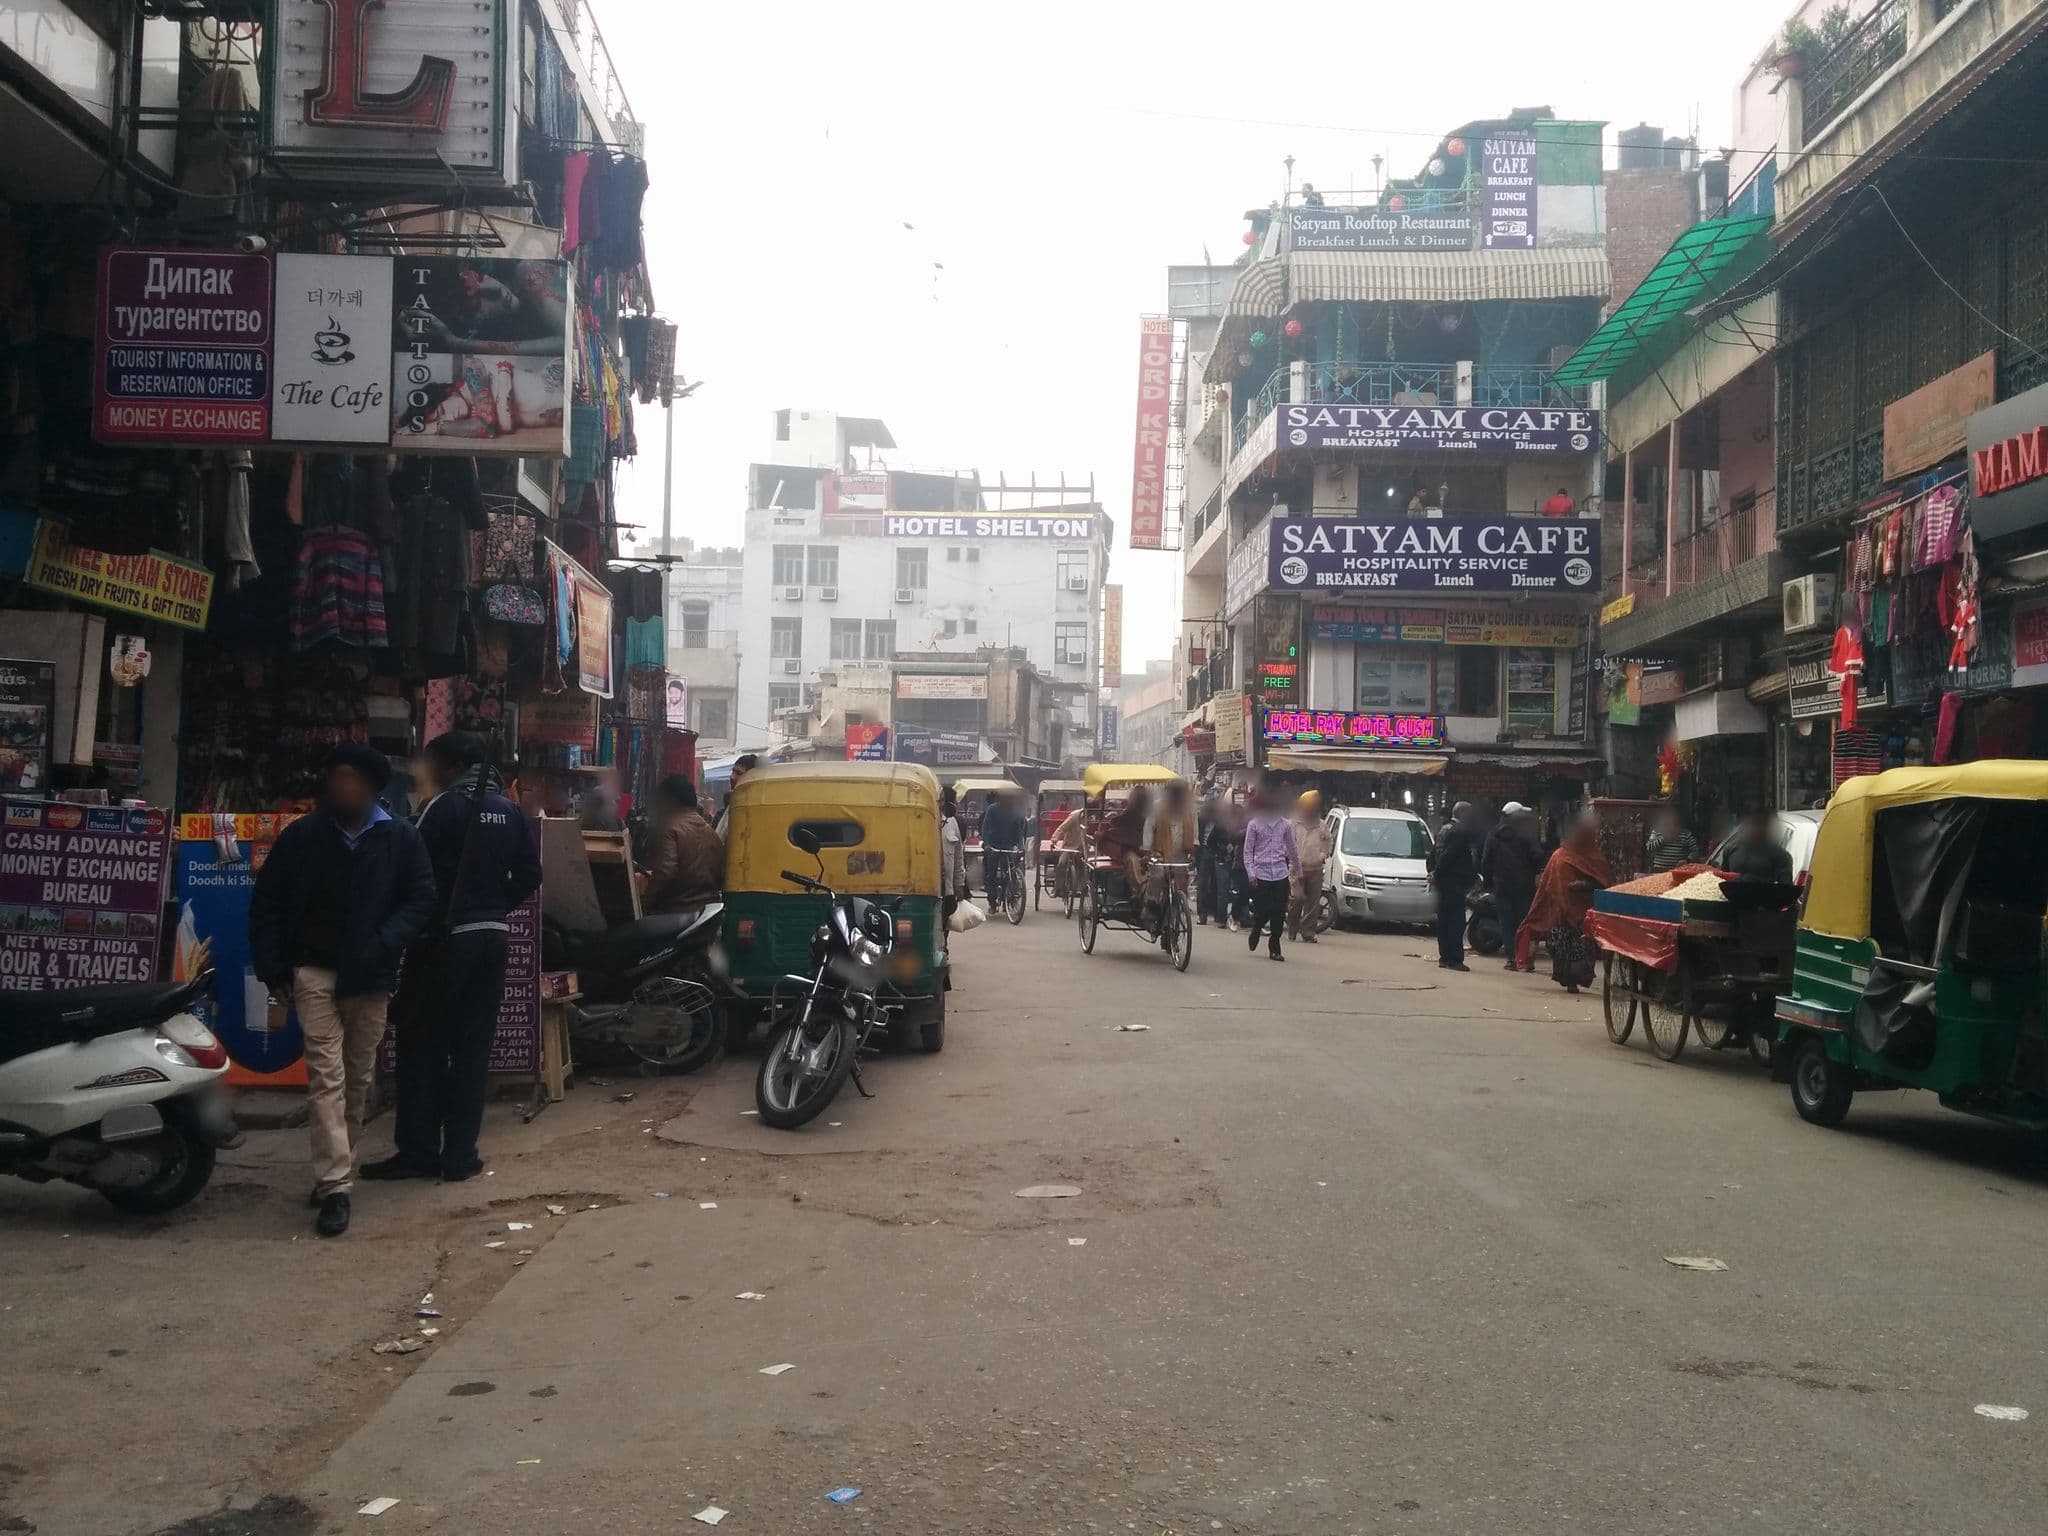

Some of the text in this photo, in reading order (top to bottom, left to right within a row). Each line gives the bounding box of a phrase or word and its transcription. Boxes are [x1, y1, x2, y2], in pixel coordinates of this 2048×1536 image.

[1484, 139, 1536, 155] SATYAM
[1493, 157, 1528, 174] CAFE
[1487, 177, 1533, 186] BREAKFAST
[1494, 192, 1526, 201] LUNCH
[1492, 208, 1528, 217] DINNER
[1293, 215, 1471, 235] Satyam Rooftop Restaurant
[1297, 235, 1468, 247] Breakfast Lunch & Dinner
[144, 257, 233, 299] Дипак
[115, 306, 262, 336] турагентство
[1142, 320, 1171, 335] HOTEL
[111, 350, 264, 372] TOURIST INFORMATION &
[407, 268, 431, 434] TATTOOS
[1141, 335, 1167, 401] LORD
[120, 374, 253, 396] RESERVATION OFFICE
[281, 380, 384, 414] The Cafe
[110, 407, 262, 431] MONEY EXCHANGE
[1287, 406, 1593, 432] SATYAM CAFE
[1322, 437, 1558, 451] BREAKFAST Lunch Dinner
[1348, 429, 1531, 441] HOSPITALITY SERVICE
[1973, 424, 2048, 498] MAM
[1133, 413, 1163, 530] KRISHNA
[888, 517, 1089, 537] HOTEL SHELTON
[1282, 525, 1590, 556] SATYAM CAFE
[1343, 557, 1528, 570] HOSPITALITY SERVICE
[162, 562, 209, 602] STORE
[1316, 573, 1556, 587] BREAKFAST Lunch Dinner
[41, 563, 202, 624] FRESH DRY FRUITS & GIFT ITEMS
[1447, 611, 1485, 626] SATYAM
[1488, 612, 1531, 627] COURIER
[1264, 678, 1292, 688] FREE
[1790, 661, 1819, 685] PODDAR
[1271, 713, 1346, 735] HOTEL RAK
[1350, 717, 1393, 737] HOTEL
[13, 808, 35, 819] VISA
[131, 816, 162, 827] Maestro
[90, 821, 120, 831] Electron
[5, 832, 162, 858] CASH ADVANCE
[1, 853, 159, 882] MONEY EXCHANGE
[188, 875, 225, 887] Doodh
[227, 875, 237, 887] ki
[42, 881, 112, 905] BUREAU
[7, 935, 139, 955] NET WEST INDIA
[0, 950, 150, 981] OUR & TRAVELS
[1, 975, 44, 991] REE
